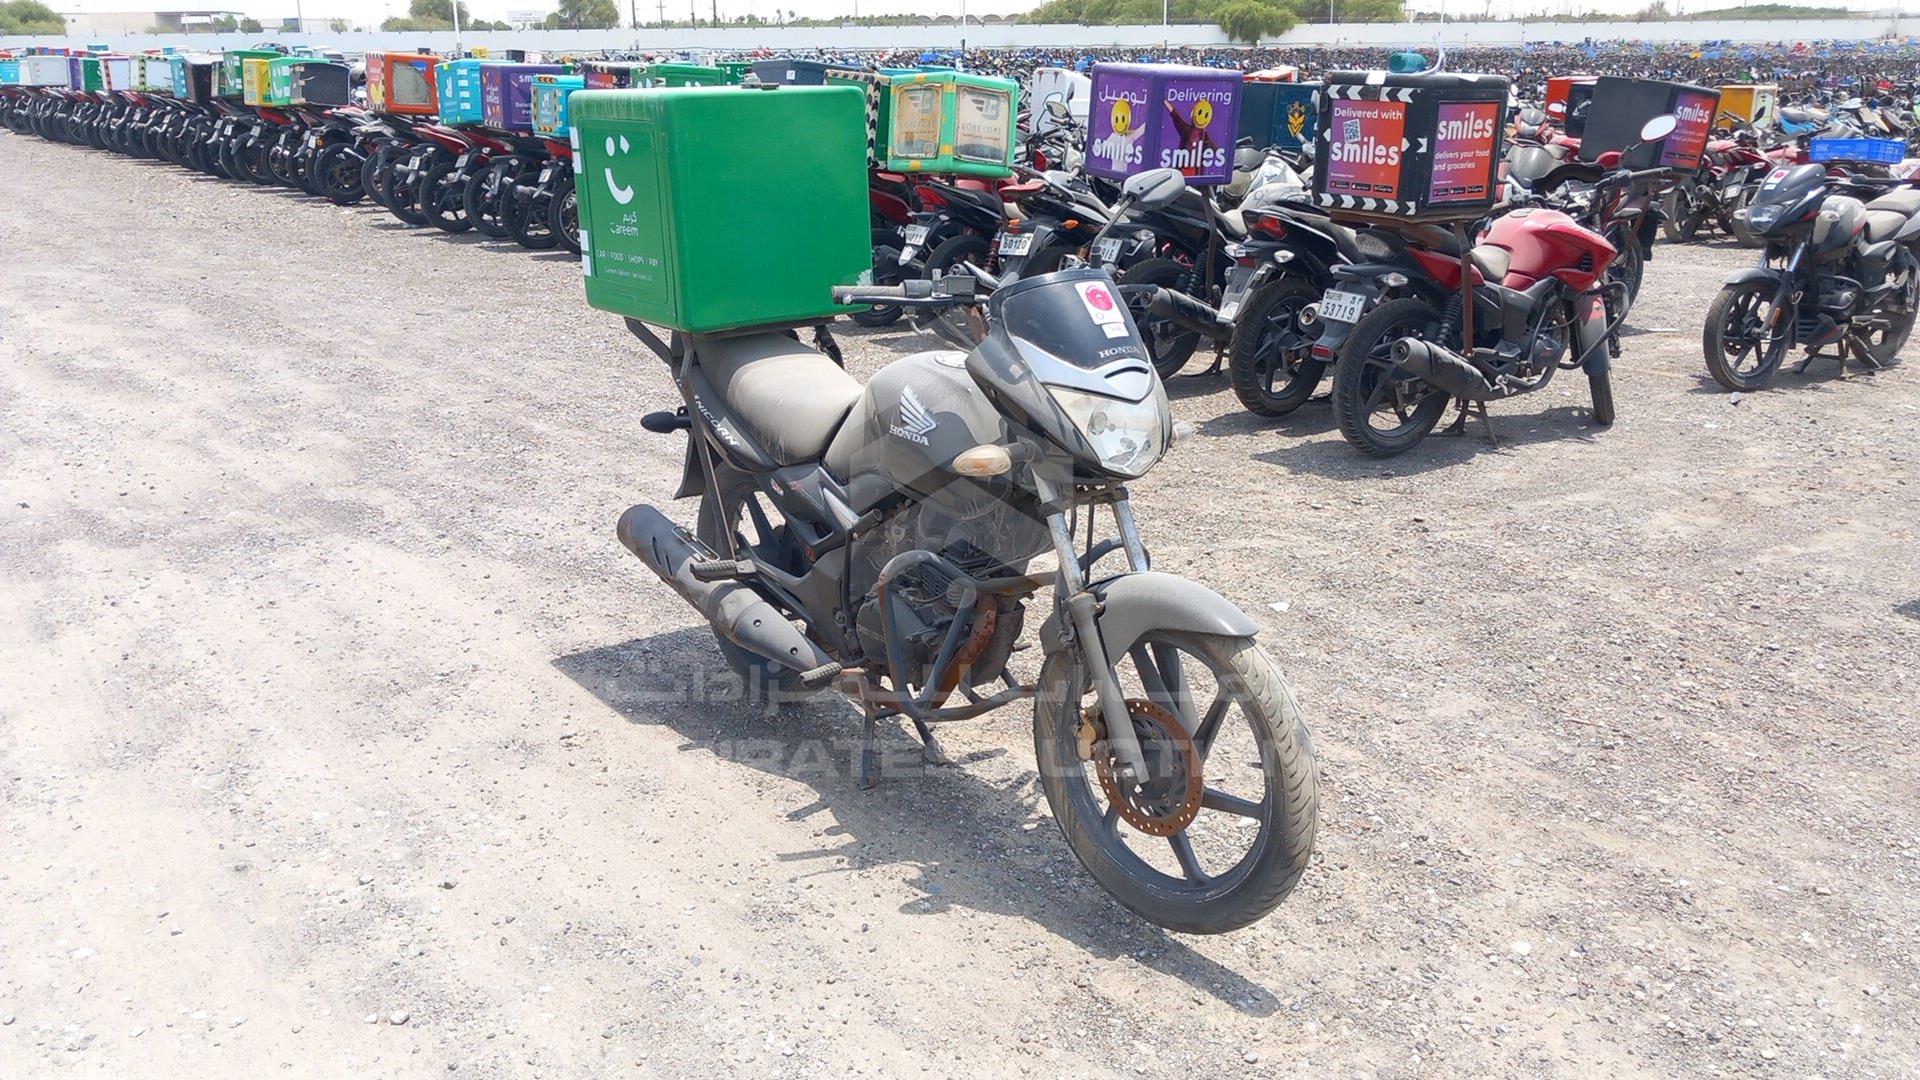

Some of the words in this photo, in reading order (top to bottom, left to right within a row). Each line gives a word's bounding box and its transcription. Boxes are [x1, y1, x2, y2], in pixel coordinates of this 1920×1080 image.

[1167, 87, 1232, 105] Delivering
[1333, 107, 1379, 119] Delivered
[1380, 109, 1403, 120] with
[1676, 103, 1710, 123] smiles
[1436, 110, 1493, 141] smiles
[1092, 135, 1143, 165] smiles
[1160, 140, 1226, 168] smiles
[1331, 135, 1400, 166] smiles
[1434, 151, 1459, 160] delivers
[1459, 151, 1475, 160] your
[1475, 149, 1490, 158] food
[1433, 163, 1446, 171] and
[1446, 161, 1476, 172] groceries
[610, 222, 639, 237] Careem
[1322, 302, 1355, 321] 53719
[1098, 346, 1140, 358] HONDA
[888, 424, 931, 447] HONDA
